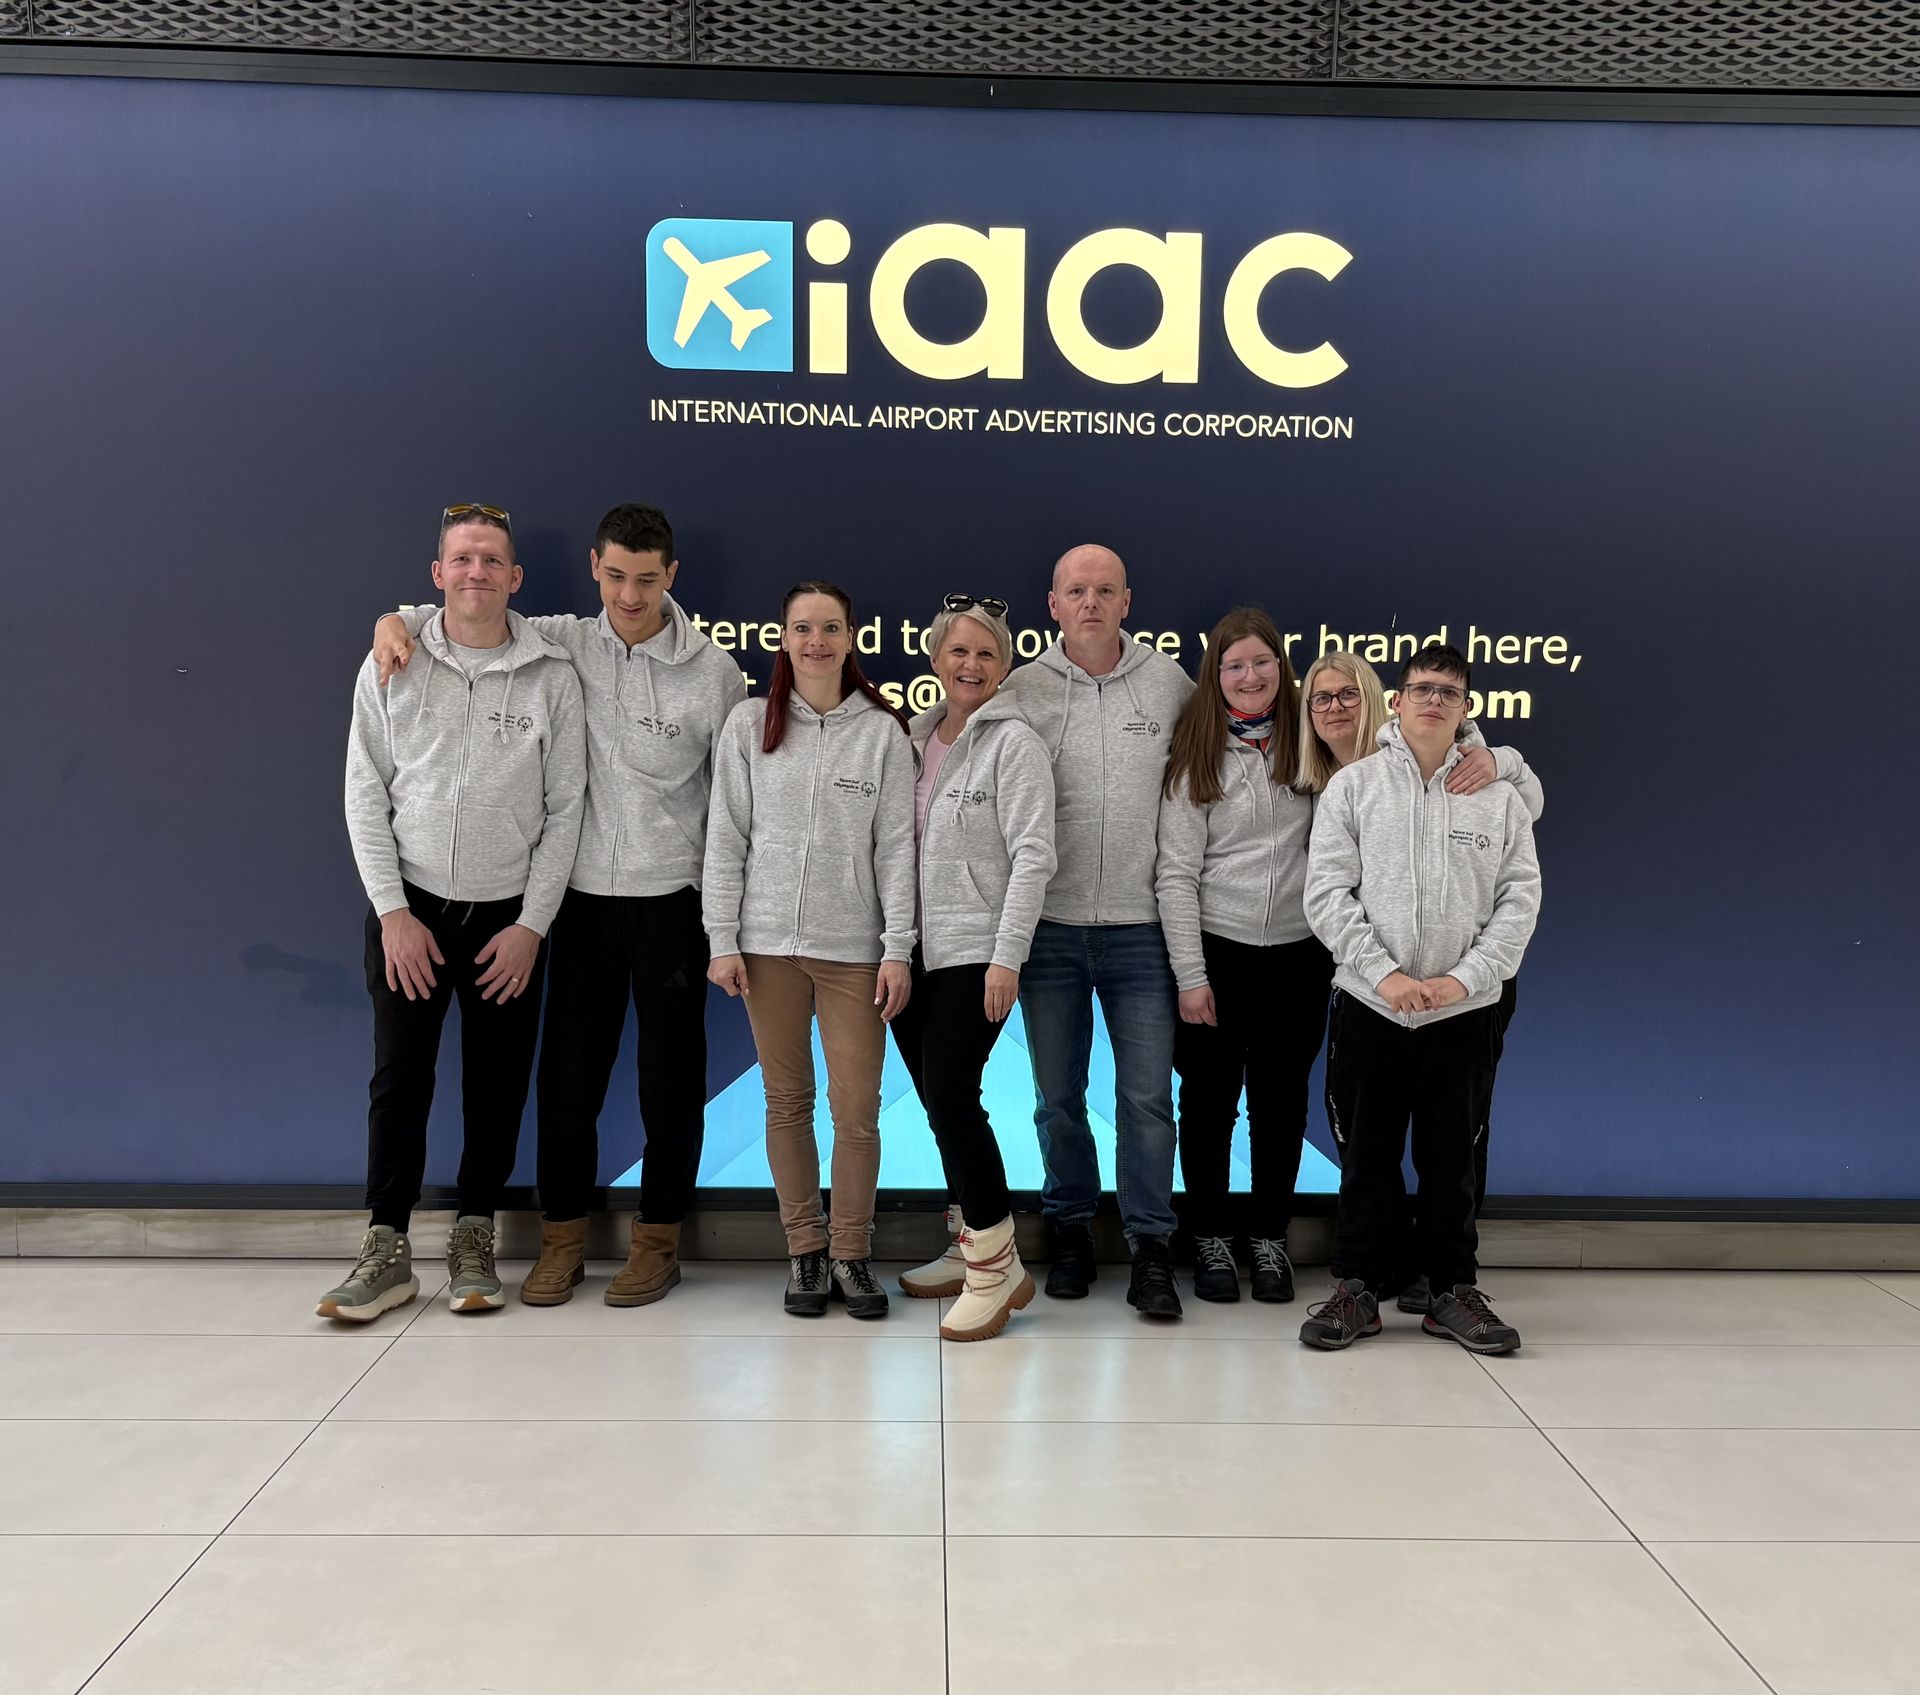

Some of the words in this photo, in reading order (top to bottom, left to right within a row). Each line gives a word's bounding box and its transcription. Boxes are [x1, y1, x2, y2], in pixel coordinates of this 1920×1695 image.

[806, 219, 1354, 389] iaac
[651, 399, 861, 428] INTERNATIONAL
[868, 406, 979, 431] AIRPORT
[985, 409, 1155, 436] ADVERTISING
[1164, 413, 1353, 439] CORPORATION
[1467, 625, 1582, 673] here,
